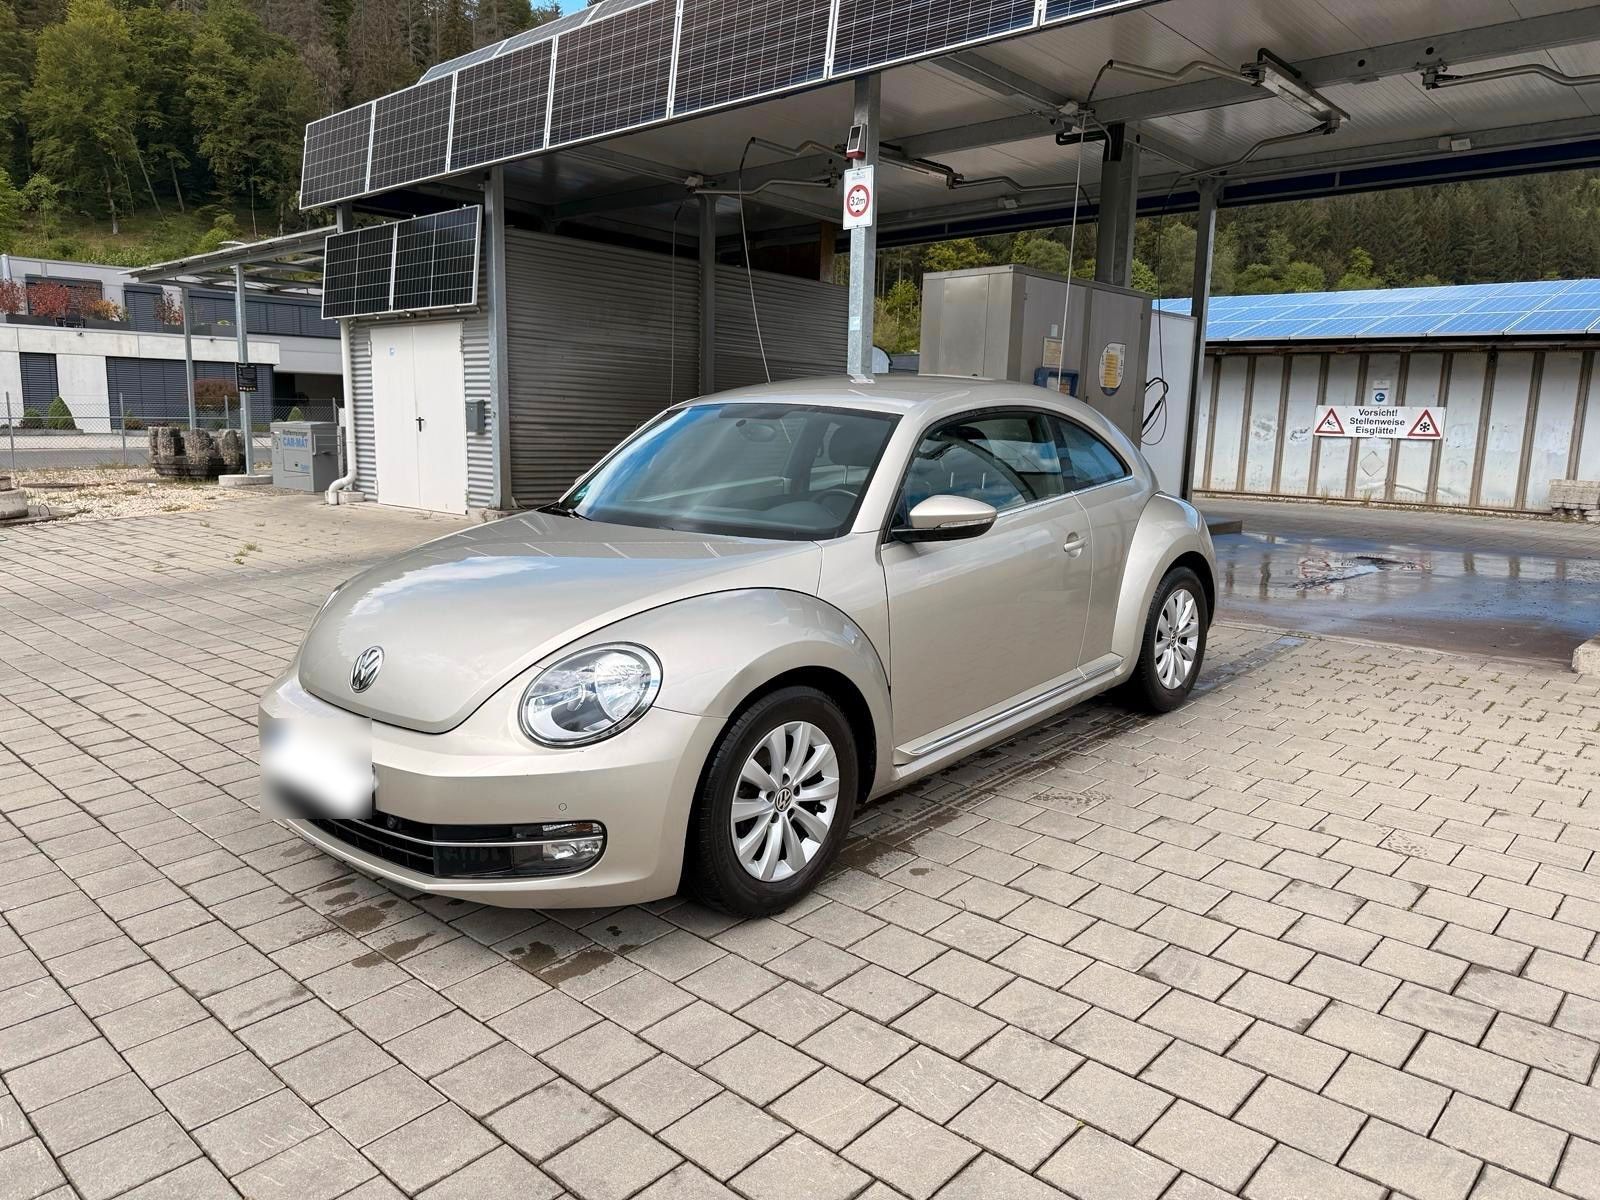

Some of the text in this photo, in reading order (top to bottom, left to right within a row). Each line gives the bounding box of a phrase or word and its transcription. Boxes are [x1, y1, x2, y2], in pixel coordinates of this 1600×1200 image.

[1358, 408, 1398, 417] Vorsicht!
[1349, 417, 1405, 426] Stellenweise
[1355, 426, 1397, 435] Eisglätte!
